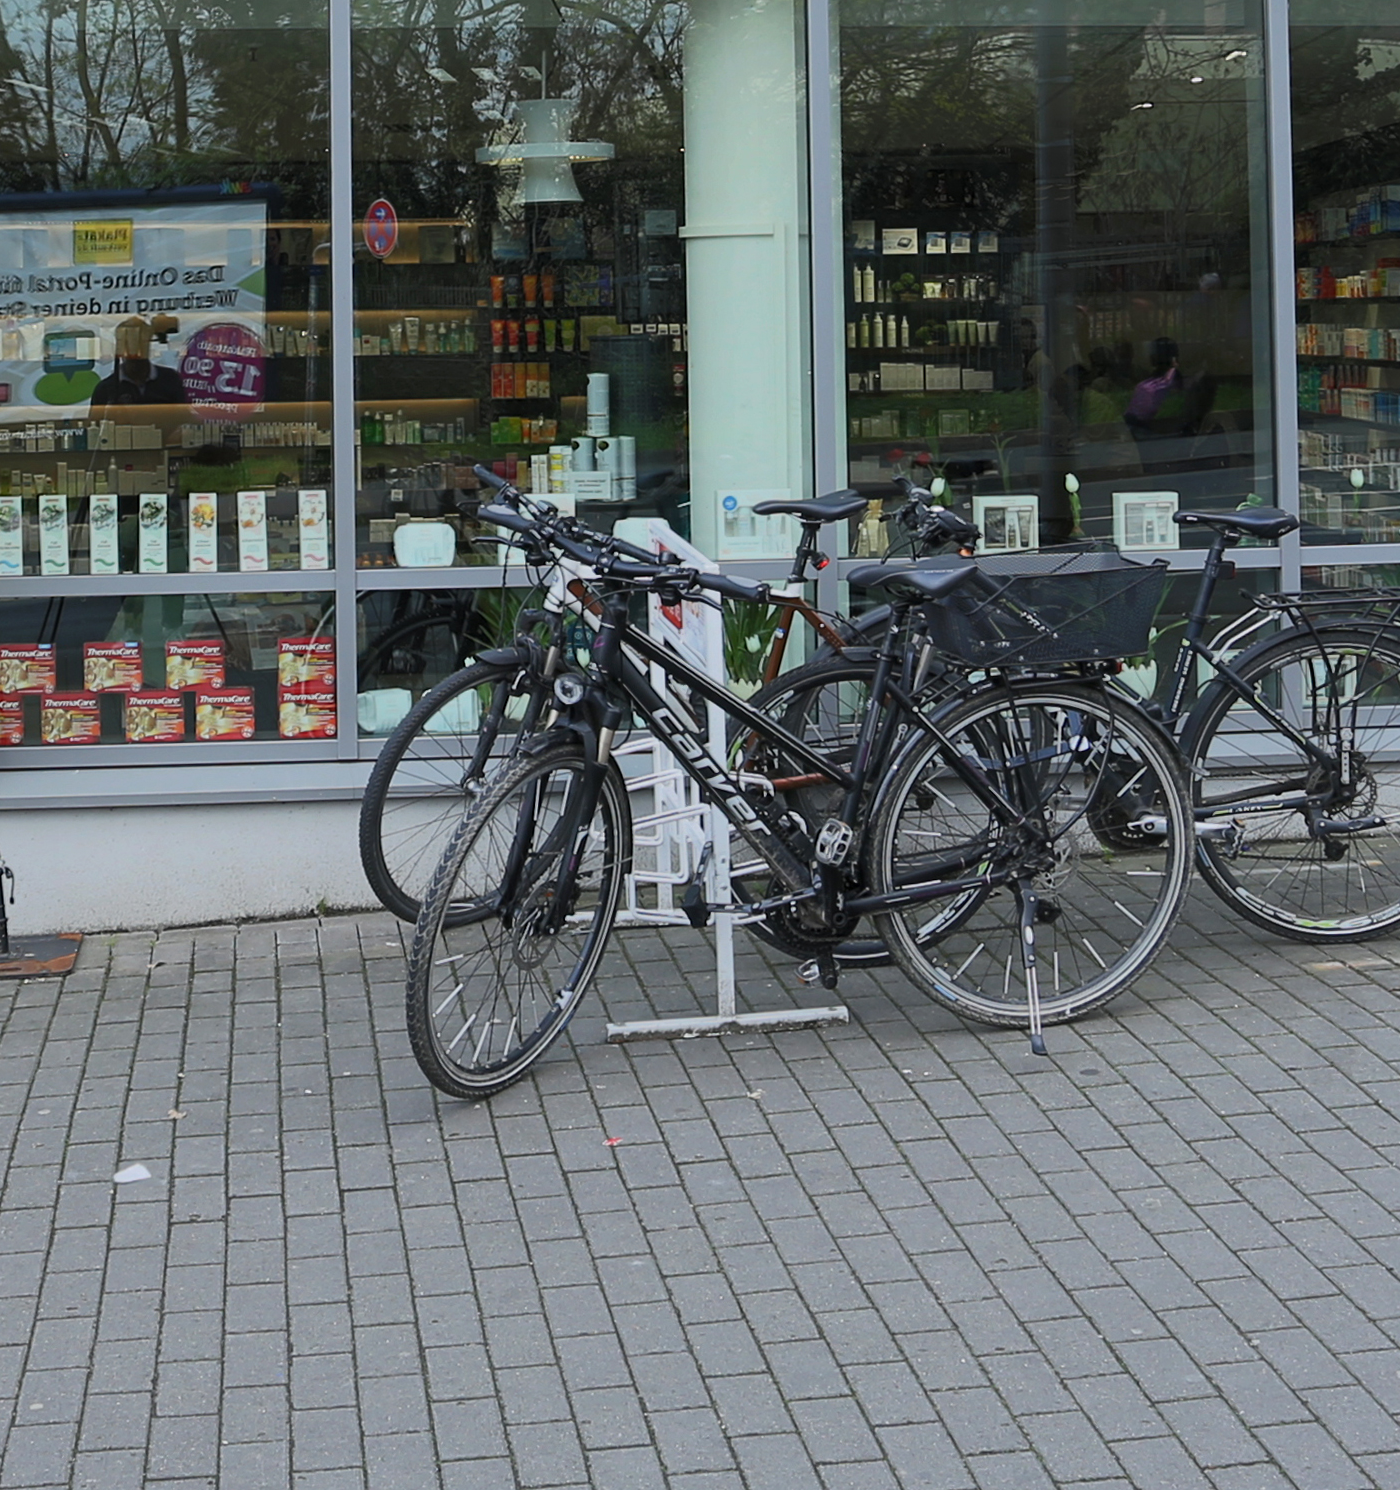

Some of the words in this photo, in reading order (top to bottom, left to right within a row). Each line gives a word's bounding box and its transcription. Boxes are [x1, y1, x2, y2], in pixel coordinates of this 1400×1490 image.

[169, 645, 221, 656] ThermaCare
[281, 642, 332, 652] ThermaCare
[0, 649, 53, 659] ThermaCare
[86, 647, 139, 658] ThermaCare
[129, 696, 181, 706] ThermaCare
[199, 694, 251, 704] ThermaCare
[283, 692, 335, 702] ThermaCare
[44, 698, 97, 709] ThermaCare
